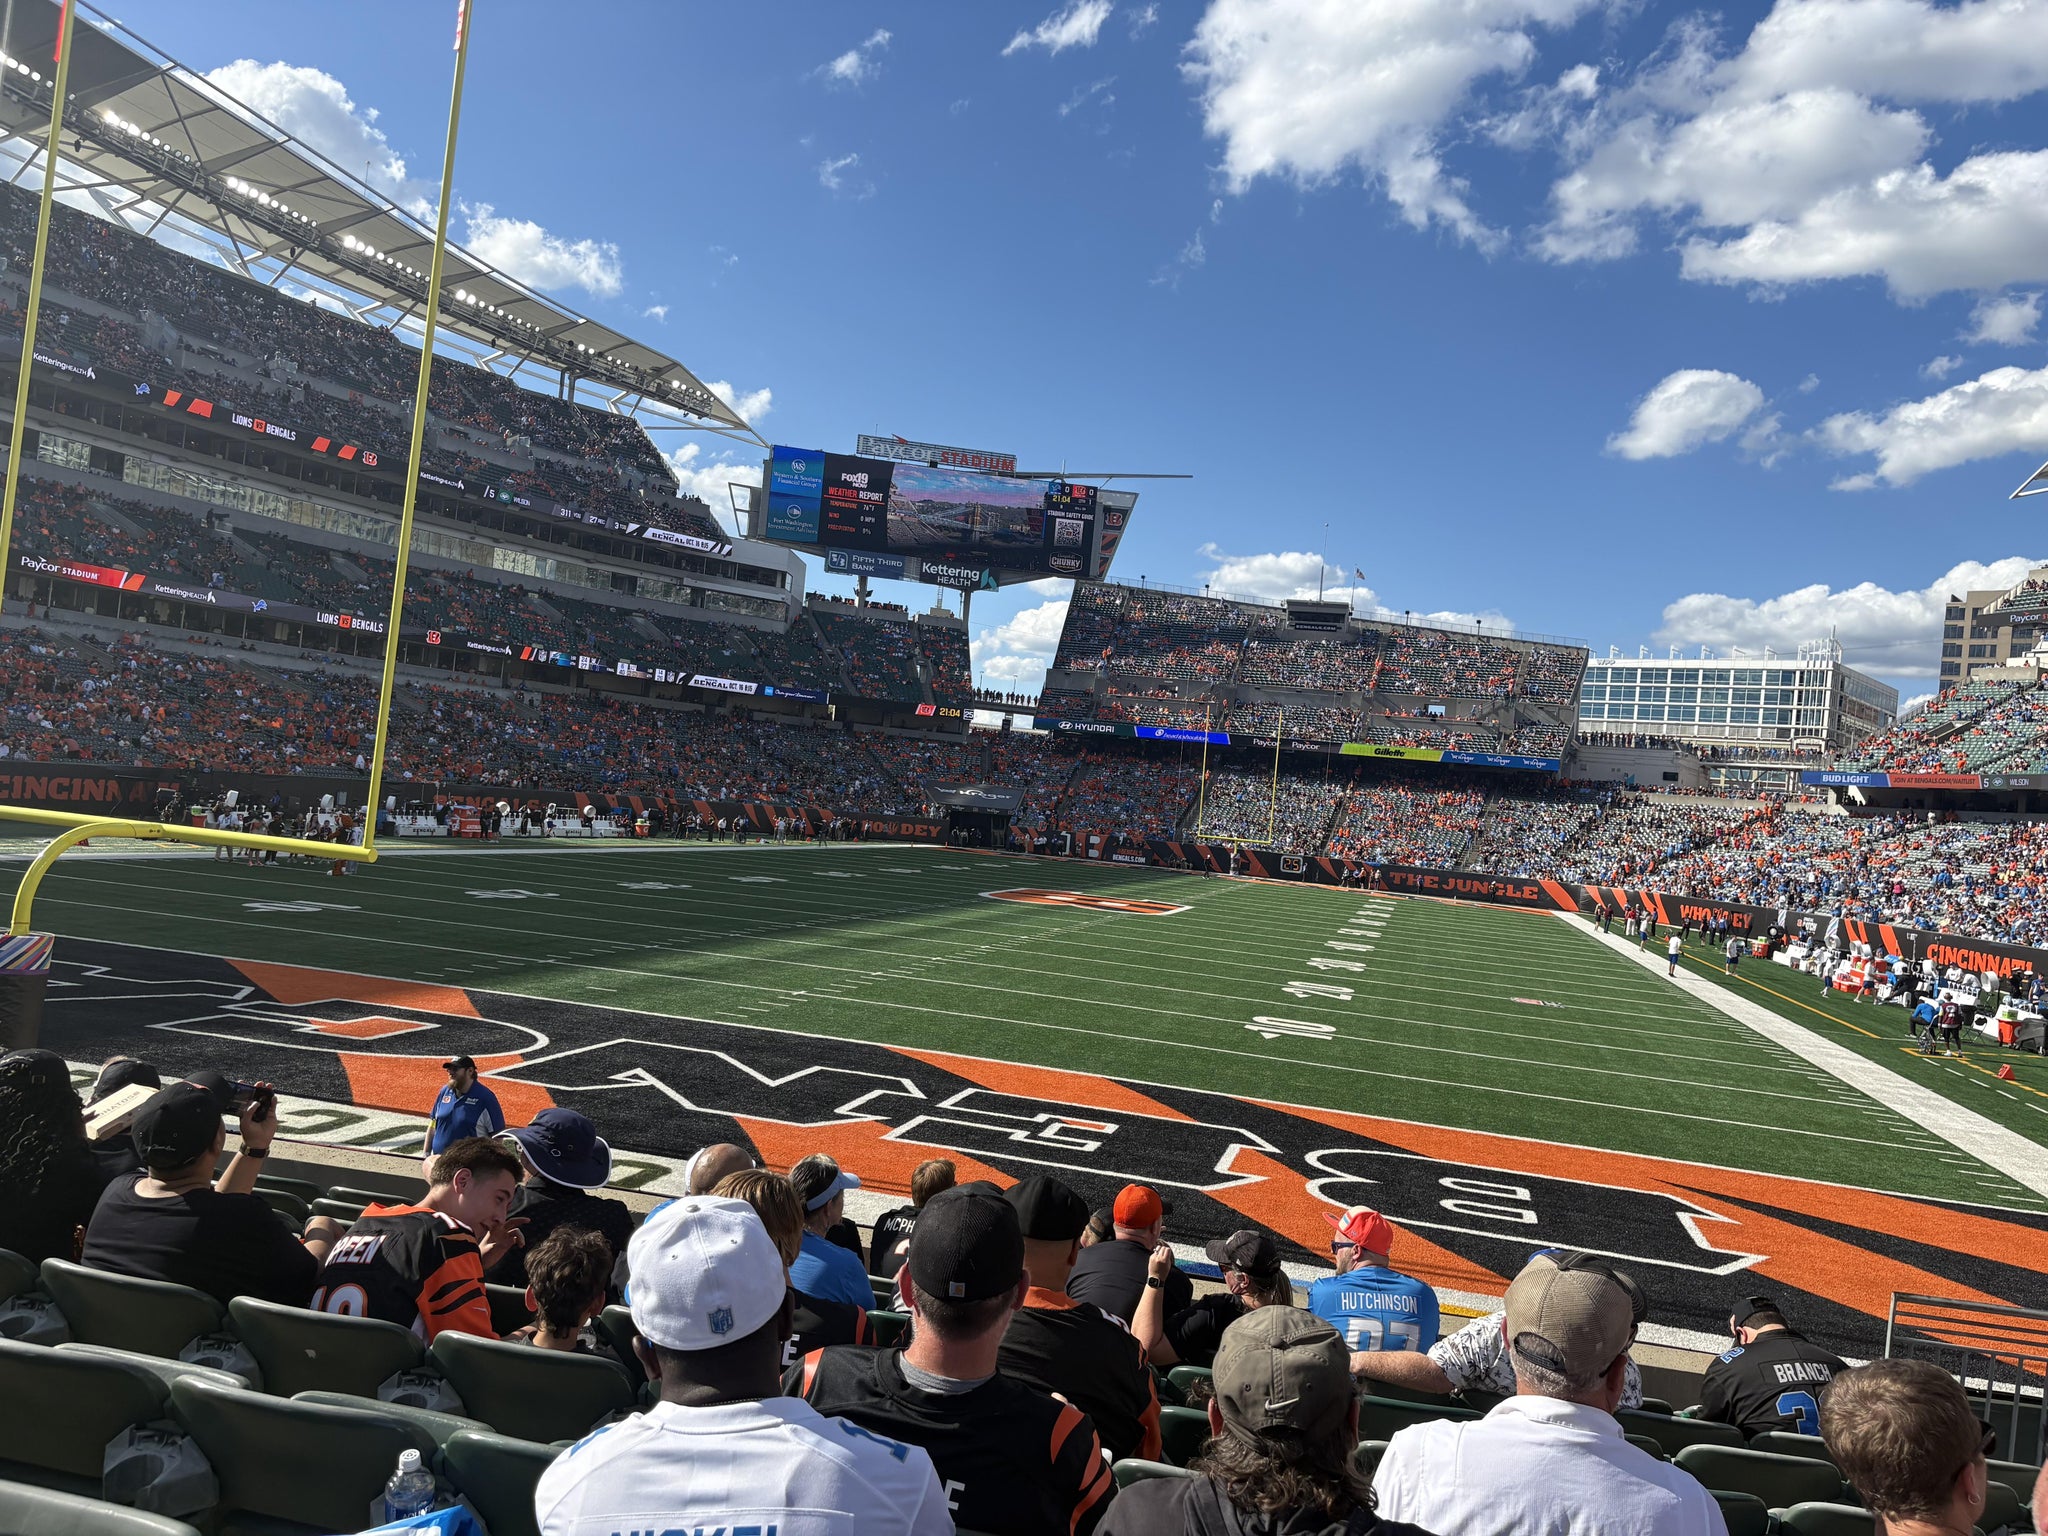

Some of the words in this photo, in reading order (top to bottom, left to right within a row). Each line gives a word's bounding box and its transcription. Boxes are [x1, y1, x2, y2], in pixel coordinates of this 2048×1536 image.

[33, 352, 66, 370] Kettering
[66, 365, 86, 376] HEALTH
[232, 413, 253, 428] LIONS
[266, 423, 297, 441] BENGALS
[858, 435, 934, 460] Paycor
[941, 450, 1015, 472] STADIUM
[420, 471, 444, 484] Kettering
[841, 472, 869, 484] FOX19
[828, 486, 858, 499] WEATHER
[859, 490, 884, 502] REPORT
[1052, 495, 1071, 503] 21:04
[513, 497, 531, 506] WILSON
[560, 508, 571, 517] 311
[589, 515, 598, 524] 27
[1047, 509, 1066, 518] STADIUM
[1066, 512, 1081, 520] SAFETY
[651, 532, 685, 545] BENGAL
[21, 555, 61, 572] Paycor
[62, 567, 99, 580] STADIUM
[851, 562, 875, 572] BANK
[852, 554, 876, 565] FIFTH
[877, 557, 903, 568] THIRD
[1051, 556, 1081, 568] CHUNKY
[922, 562, 980, 581] Kettering
[937, 576, 971, 588] HEALTH
[155, 584, 187, 598] Kettering
[187, 592, 207, 600] HEALTH
[316, 612, 339, 625] LIONS
[351, 618, 384, 632] BENGALS
[2010, 613, 2042, 624] Paycor
[467, 641, 491, 651] Kettering
[694, 679, 728, 689] BENGAL
[939, 707, 961, 718] 21:04
[964, 710, 974, 719] 25
[1074, 722, 1115, 733] HYUNDAI
[1253, 738, 1281, 748] Payco
[1291, 741, 1320, 751] Paycor
[1373, 747, 1406, 758] Gillette
[1822, 774, 1842, 783] BUD
[1842, 776, 1870, 784] LIGHT
[1983, 778, 1989, 788] 5
[2009, 778, 2030, 786] WILSON
[901, 823, 942, 838] DEY
[1112, 853, 1146, 864] BENGALS.COM
[1283, 857, 1300, 872] 25
[1389, 871, 1440, 889] THE
[1442, 877, 1539, 900] JUNGLE
[1680, 904, 1712, 921] WHO
[1243, 1016, 1337, 1041] 10
[324, 1234, 388, 1268] REEN
[1341, 1291, 1419, 1315] HUTCHINSON
[1772, 1362, 1833, 1384] BRANCH
[1775, 1390, 1824, 1436] 3
